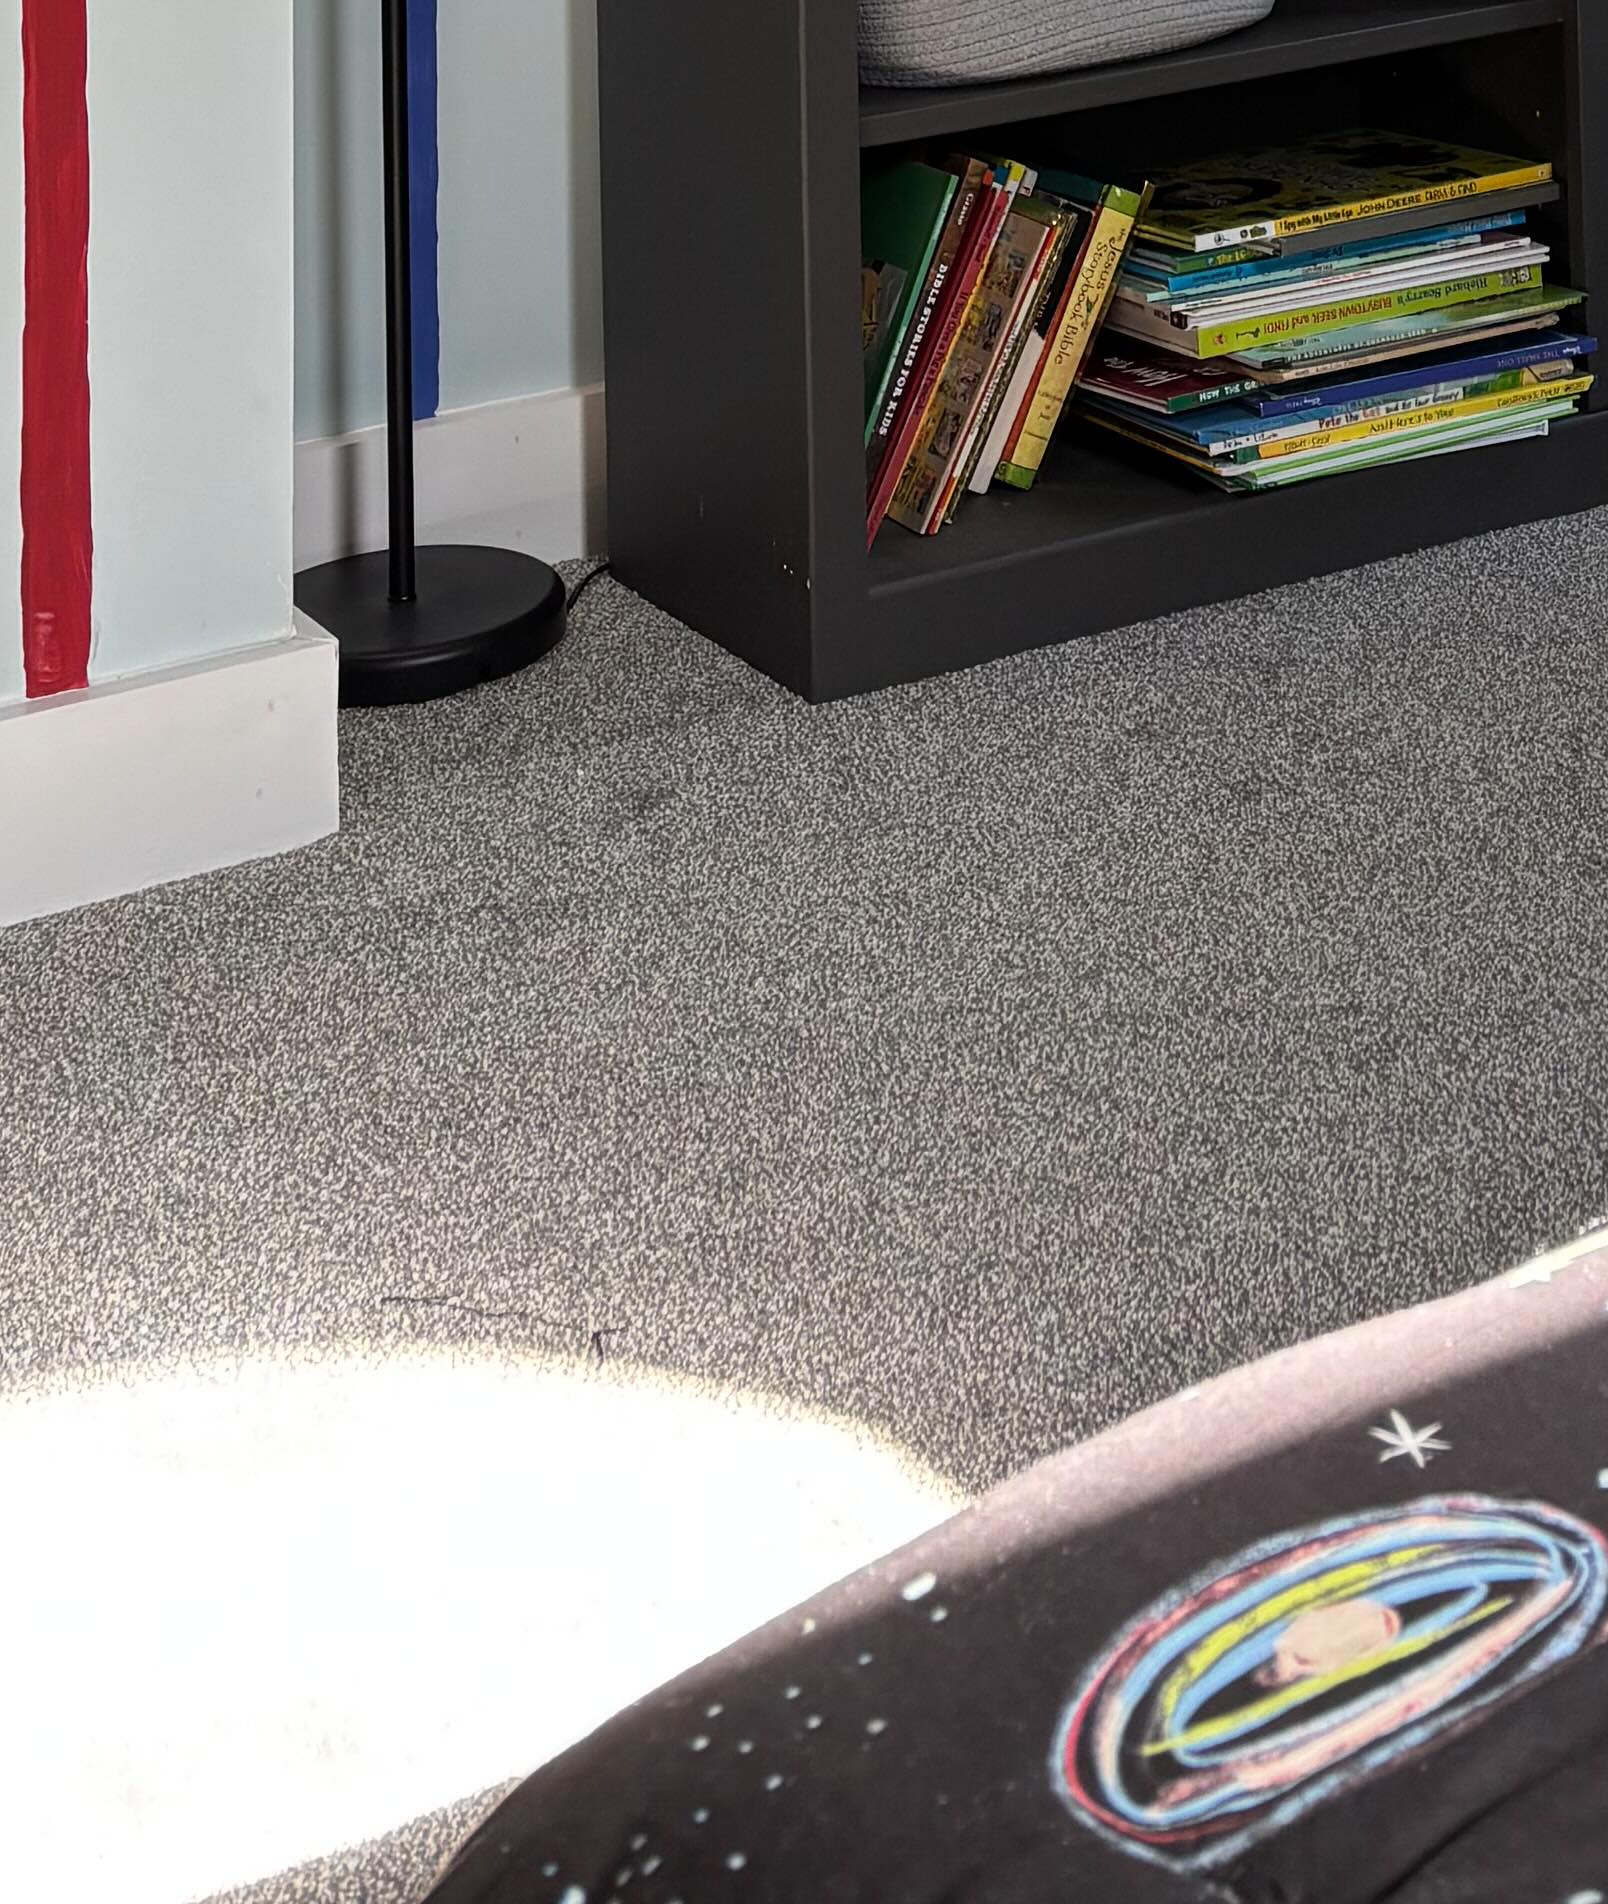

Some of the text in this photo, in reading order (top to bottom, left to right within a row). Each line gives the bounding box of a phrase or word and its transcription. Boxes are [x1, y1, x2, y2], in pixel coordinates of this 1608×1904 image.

[1282, 218, 1297, 232] Spy
[1355, 199, 1385, 216] JOHN
[1385, 190, 1422, 211] DEERE
[1091, 236, 1125, 293] Jesus
[1053, 239, 1108, 367] Storybook Bible
[1261, 276, 1488, 335] Richard Scarry's BUSYTOWN SEEK and FIND!
[877, 262, 948, 437] BIBLE STORIES FOR KIDS
[1198, 388, 1221, 403] HOW
[1223, 383, 1241, 396] THE
[1318, 415, 1342, 430] Pete
[1344, 411, 1359, 423] the
